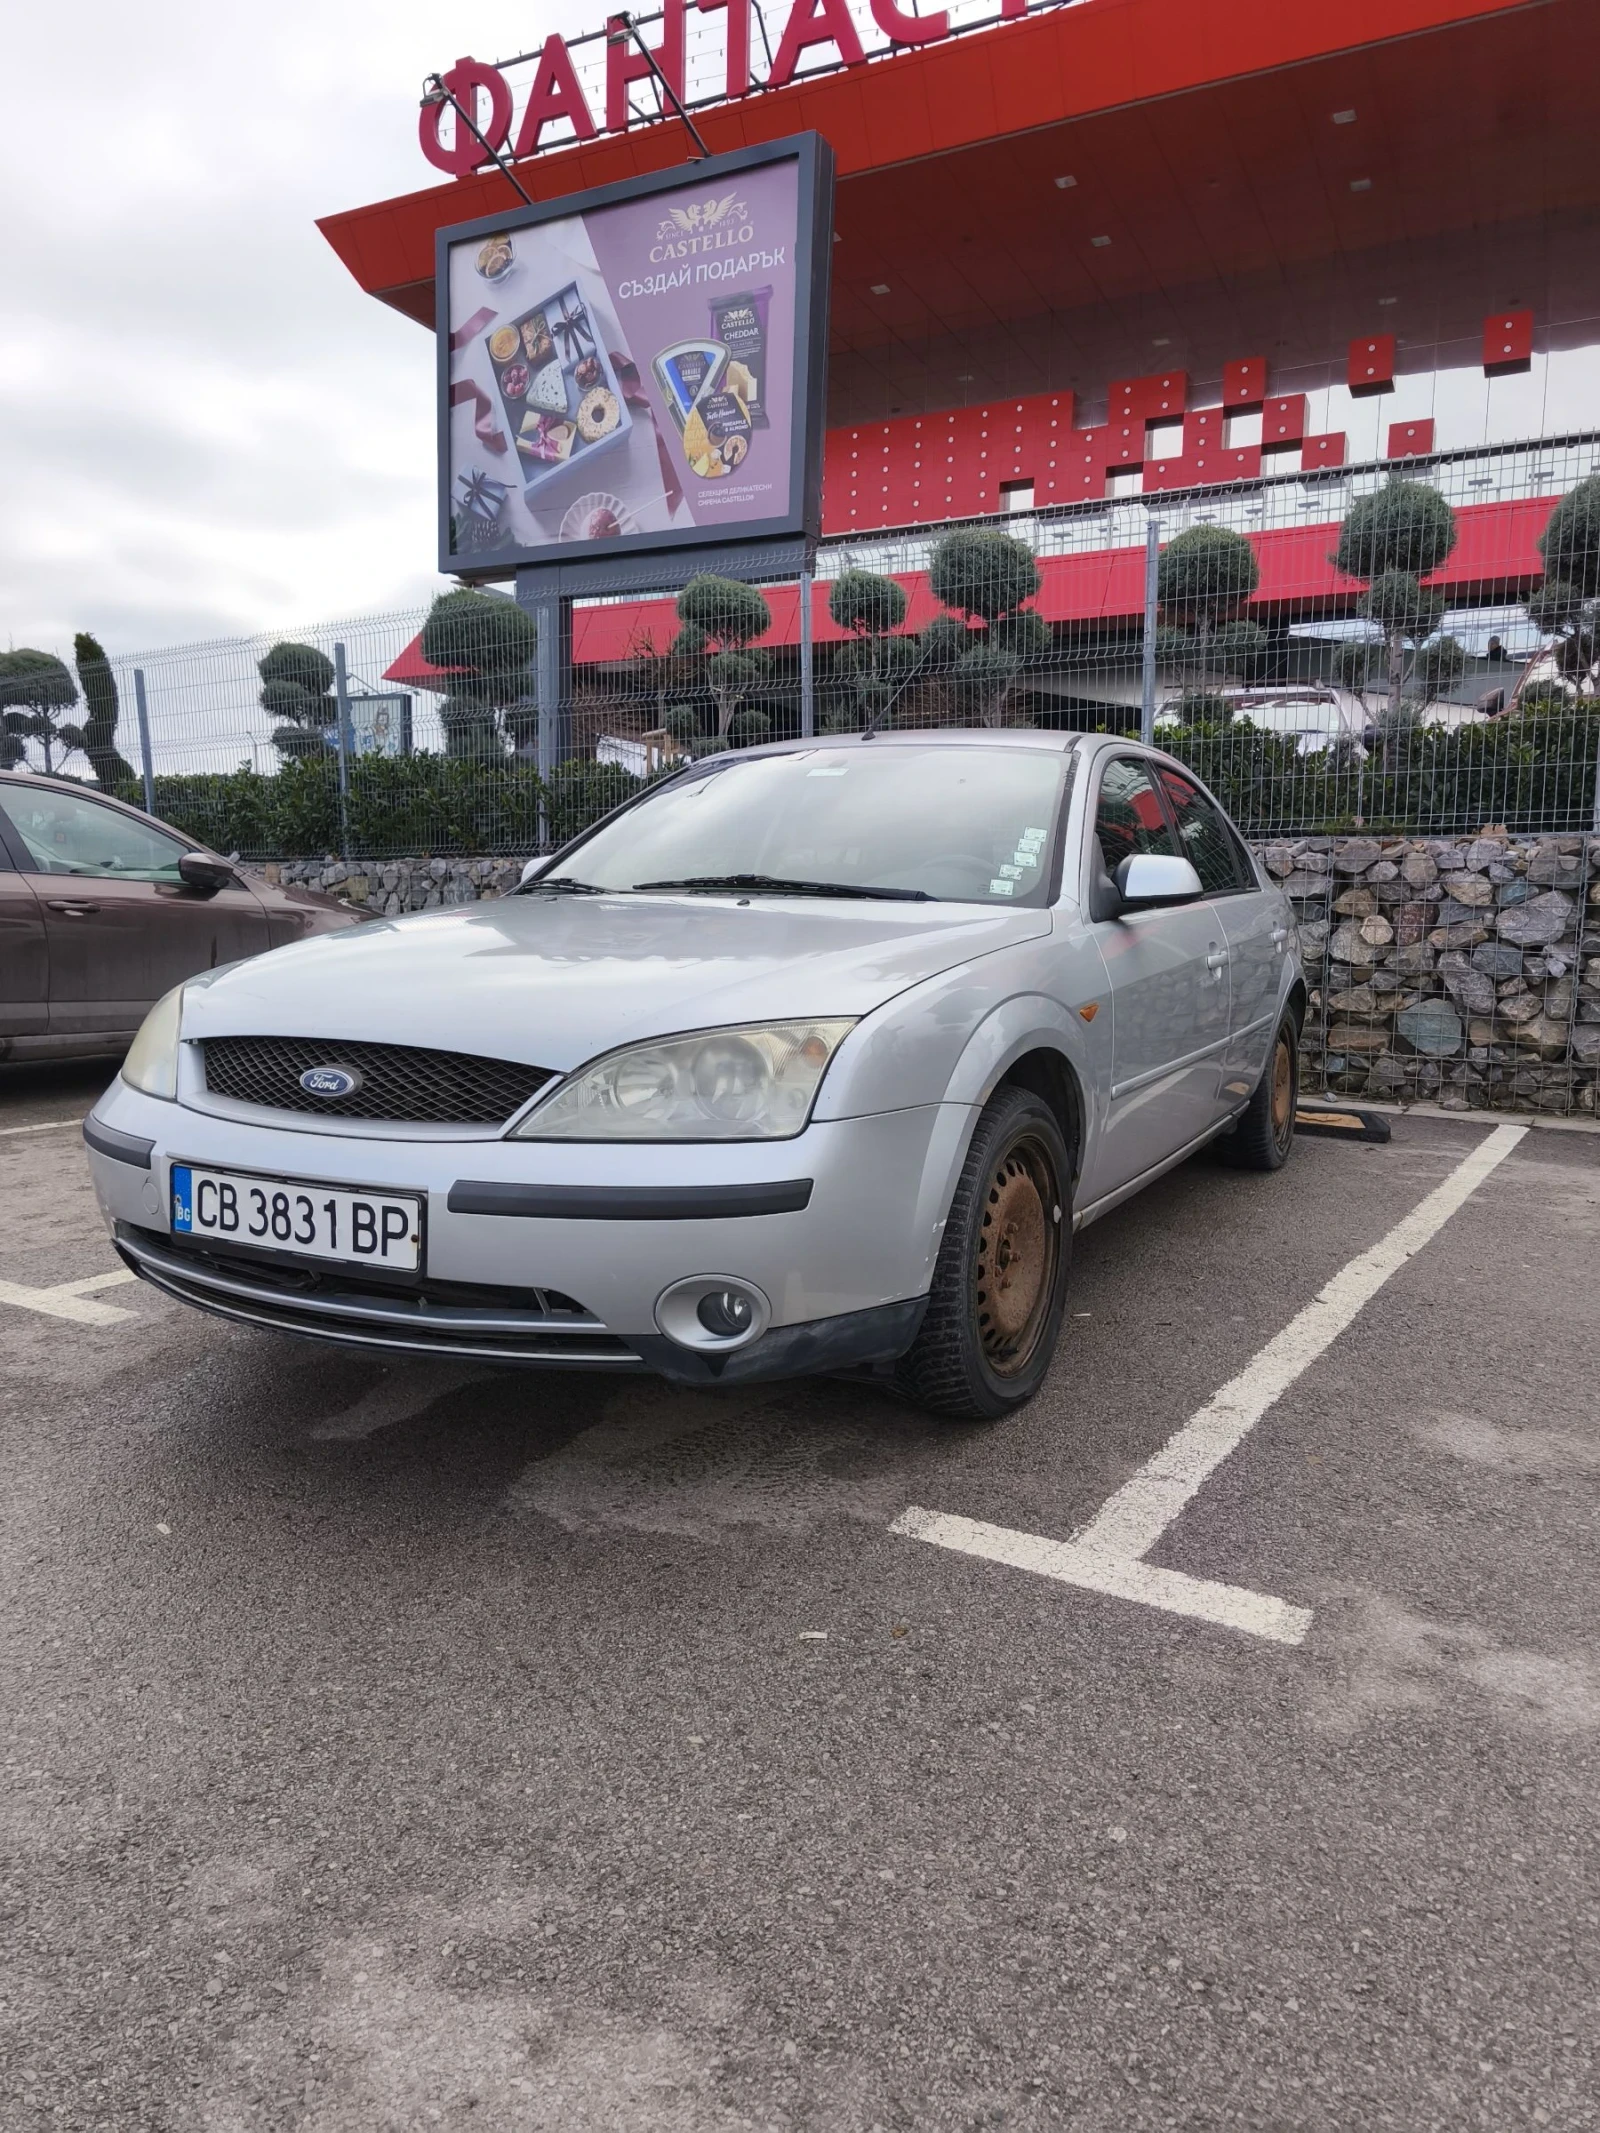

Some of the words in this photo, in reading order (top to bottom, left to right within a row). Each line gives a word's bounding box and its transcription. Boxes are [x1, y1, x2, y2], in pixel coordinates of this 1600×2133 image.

[650, 225, 754, 263] CASTELLO
[618, 263, 691, 299] СЪЗДАЙ
[695, 247, 786, 284] ПОДАРЪК
[721, 317, 755, 330] CASTELLO
[724, 327, 759, 341] CHEDDAR
[698, 488, 728, 498] СЕЛЕКЦИЯ
[729, 484, 772, 494] ДЕЛИКАТЕСНИ
[698, 499, 721, 507] СИРЕНА
[310, 1073, 340, 1091] Ford
[177, 1206, 191, 1222] BG
[197, 1179, 240, 1232] CB
[248, 1188, 337, 1249] 3831
[352, 1201, 409, 1257] BP
